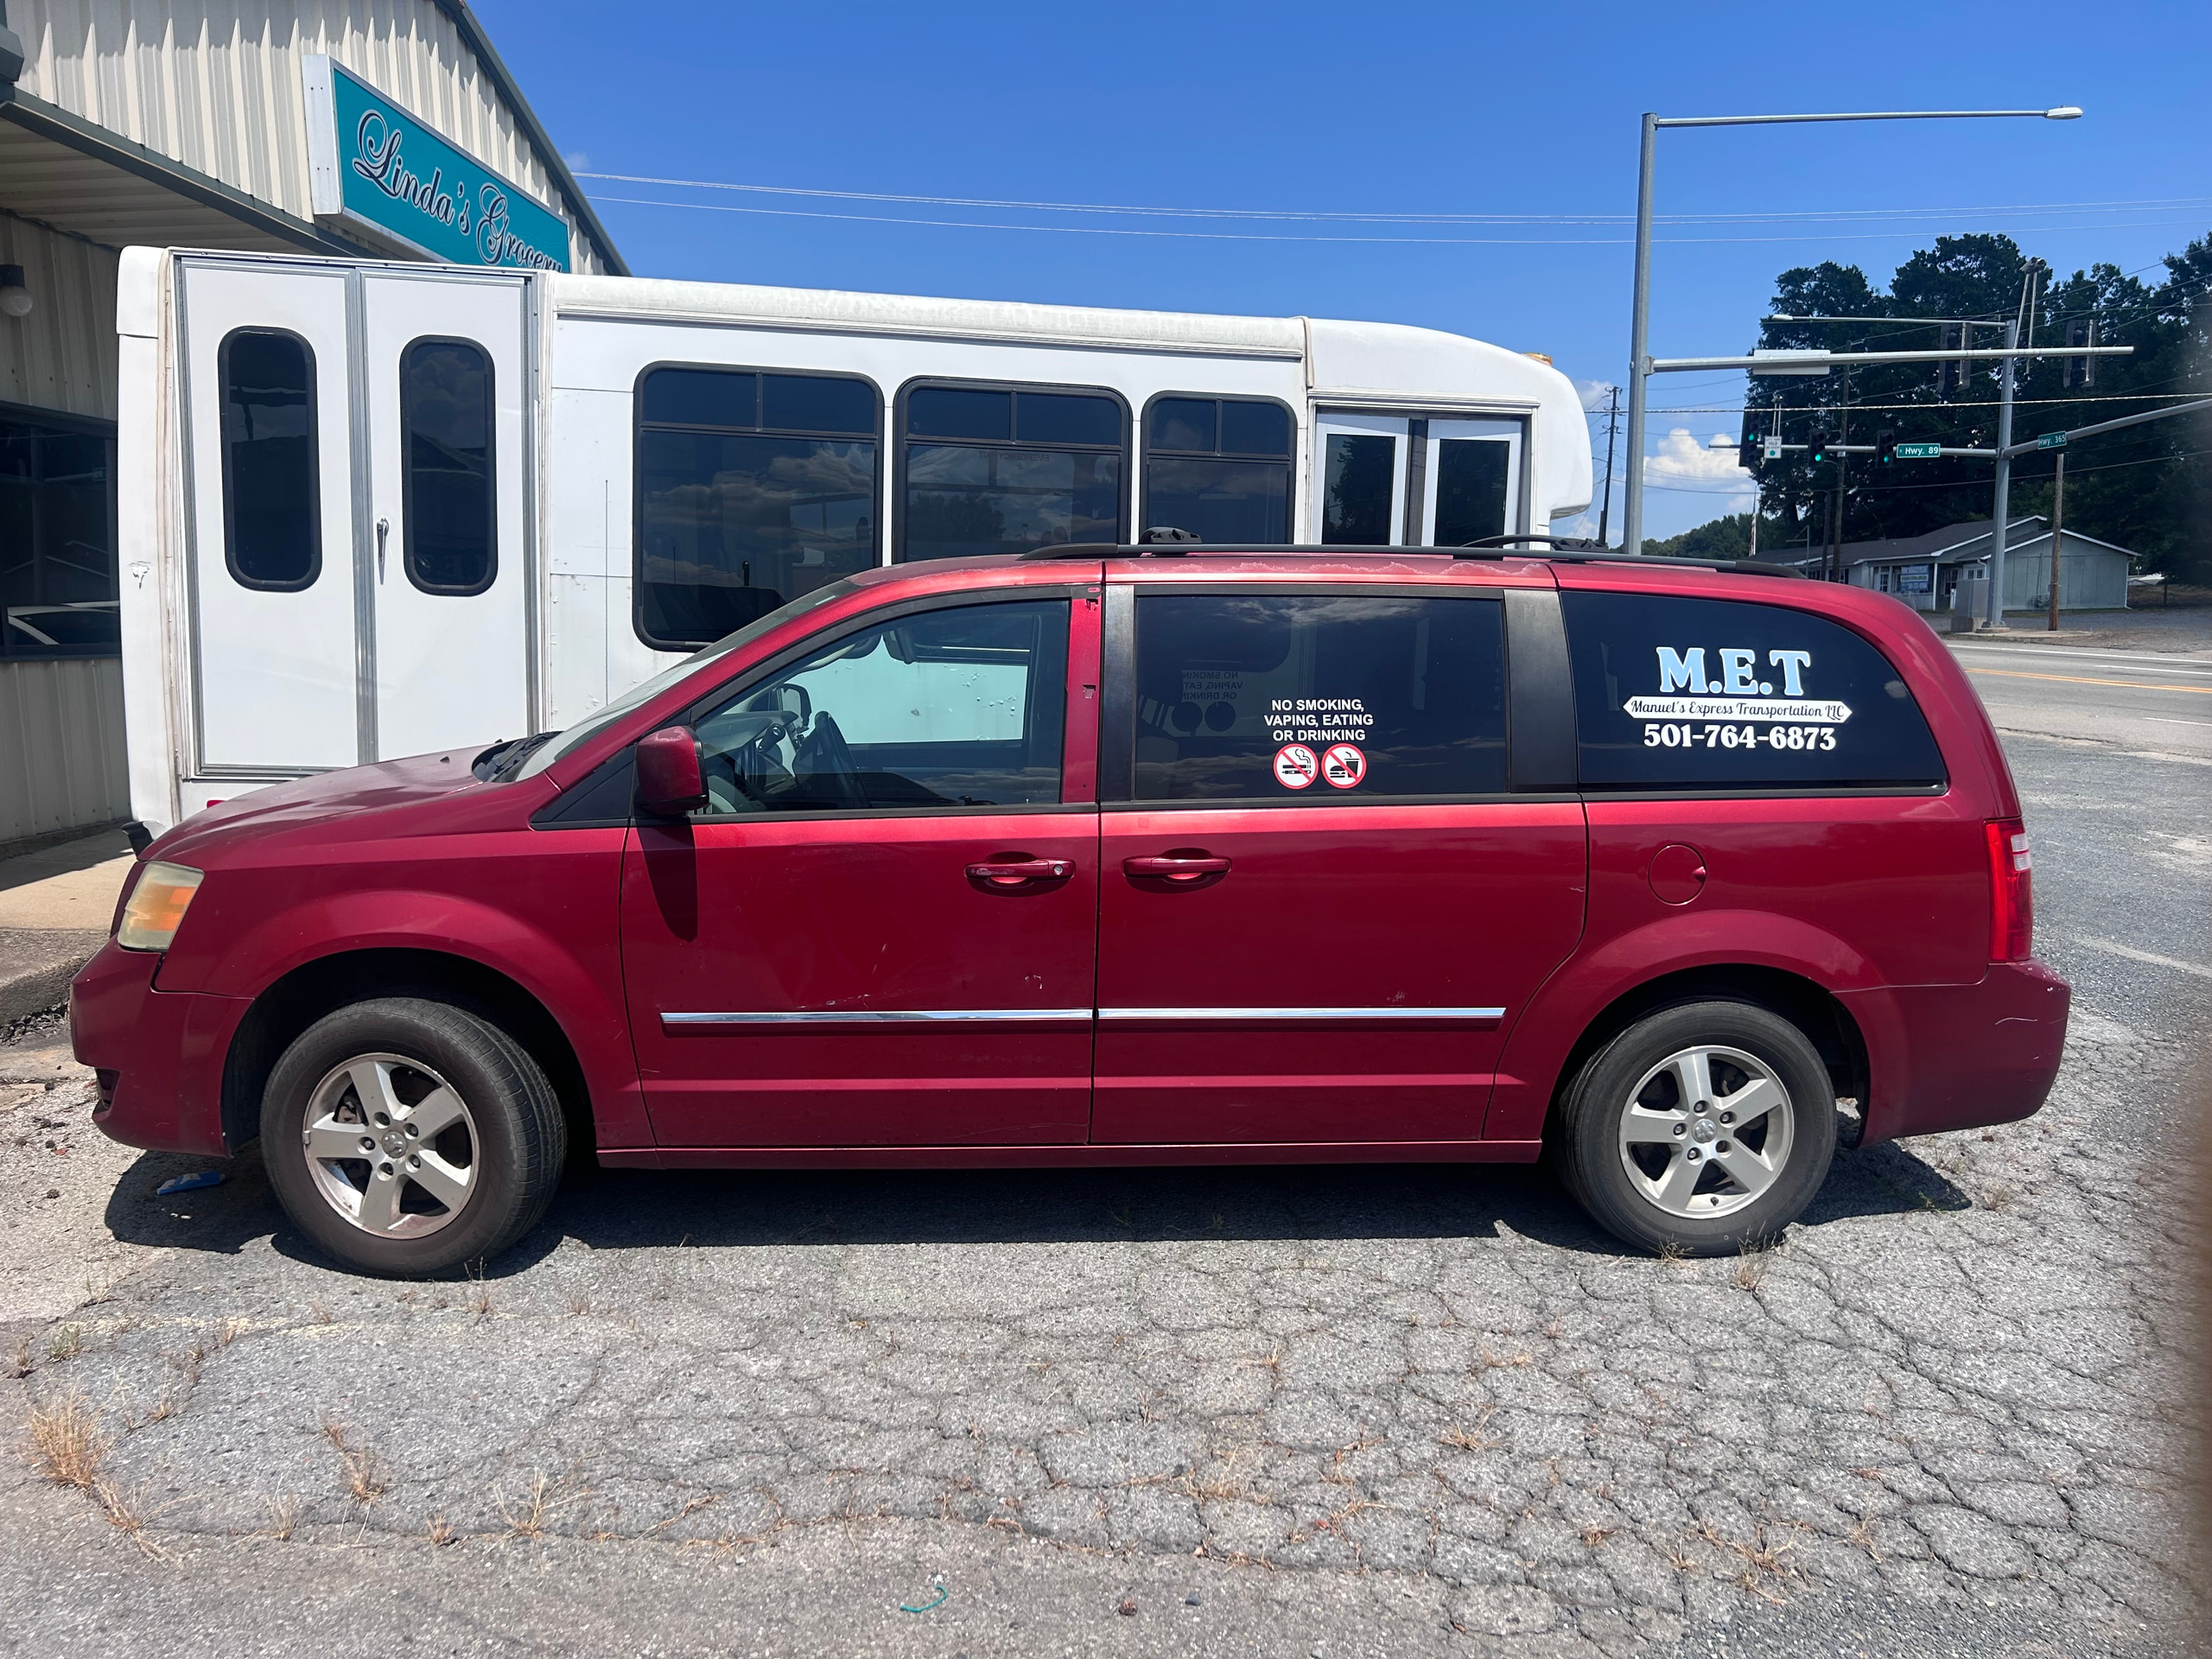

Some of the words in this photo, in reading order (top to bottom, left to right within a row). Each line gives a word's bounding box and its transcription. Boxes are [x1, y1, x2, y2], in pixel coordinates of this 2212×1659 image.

[353, 109, 471, 235] Linda's
[2054, 434, 2066, 443] 365
[1904, 447, 1925, 456] Hwy.
[1928, 446, 1939, 454] 89
[1656, 645, 1811, 696] M.E.T
[1271, 699, 1293, 711] NO
[1295, 698, 1364, 712] SMOKING,
[1630, 700, 1686, 714] Manuel's
[1688, 702, 1734, 716] Express
[1736, 702, 1823, 719] Transportation
[1824, 705, 1845, 721] LLC
[1264, 715, 1319, 728] VAPING,
[1322, 714, 1374, 726] EATING
[1273, 729, 1294, 741] OR
[1297, 729, 1366, 741] DRINKING
[1643, 723, 1836, 751] 501-764-6873
